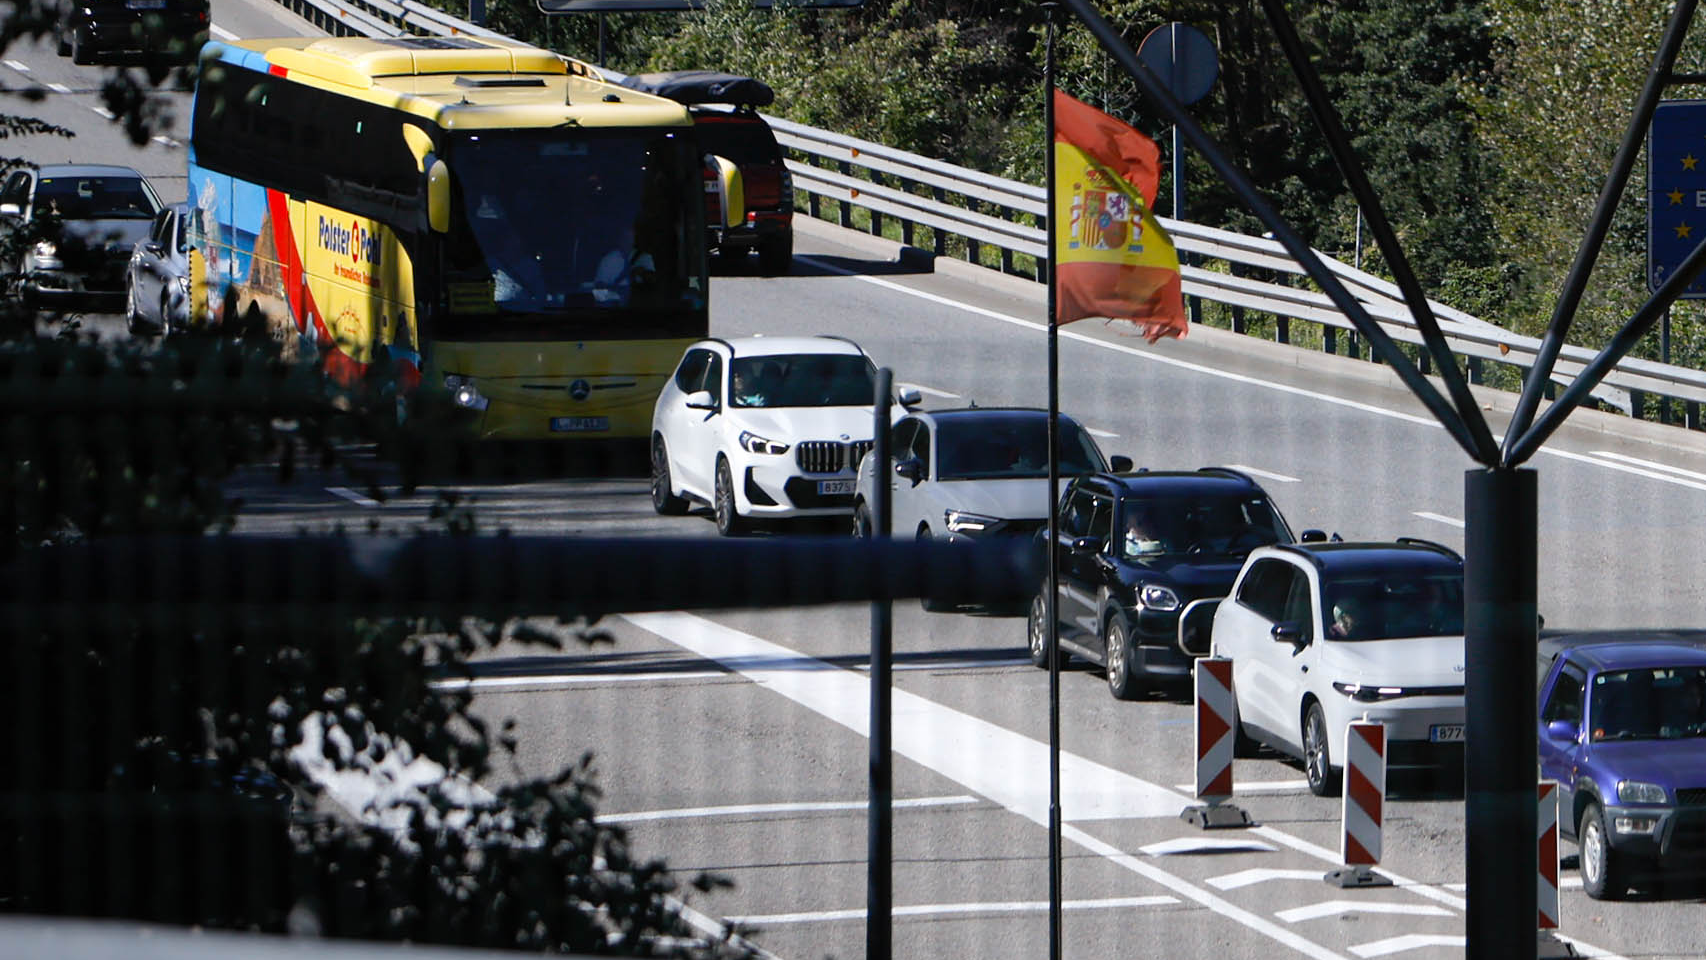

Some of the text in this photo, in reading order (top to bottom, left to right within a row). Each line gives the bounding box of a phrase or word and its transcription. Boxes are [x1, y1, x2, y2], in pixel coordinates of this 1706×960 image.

[318, 214, 382, 267] Polster Pohl
[1440, 726, 1465, 739] 877
